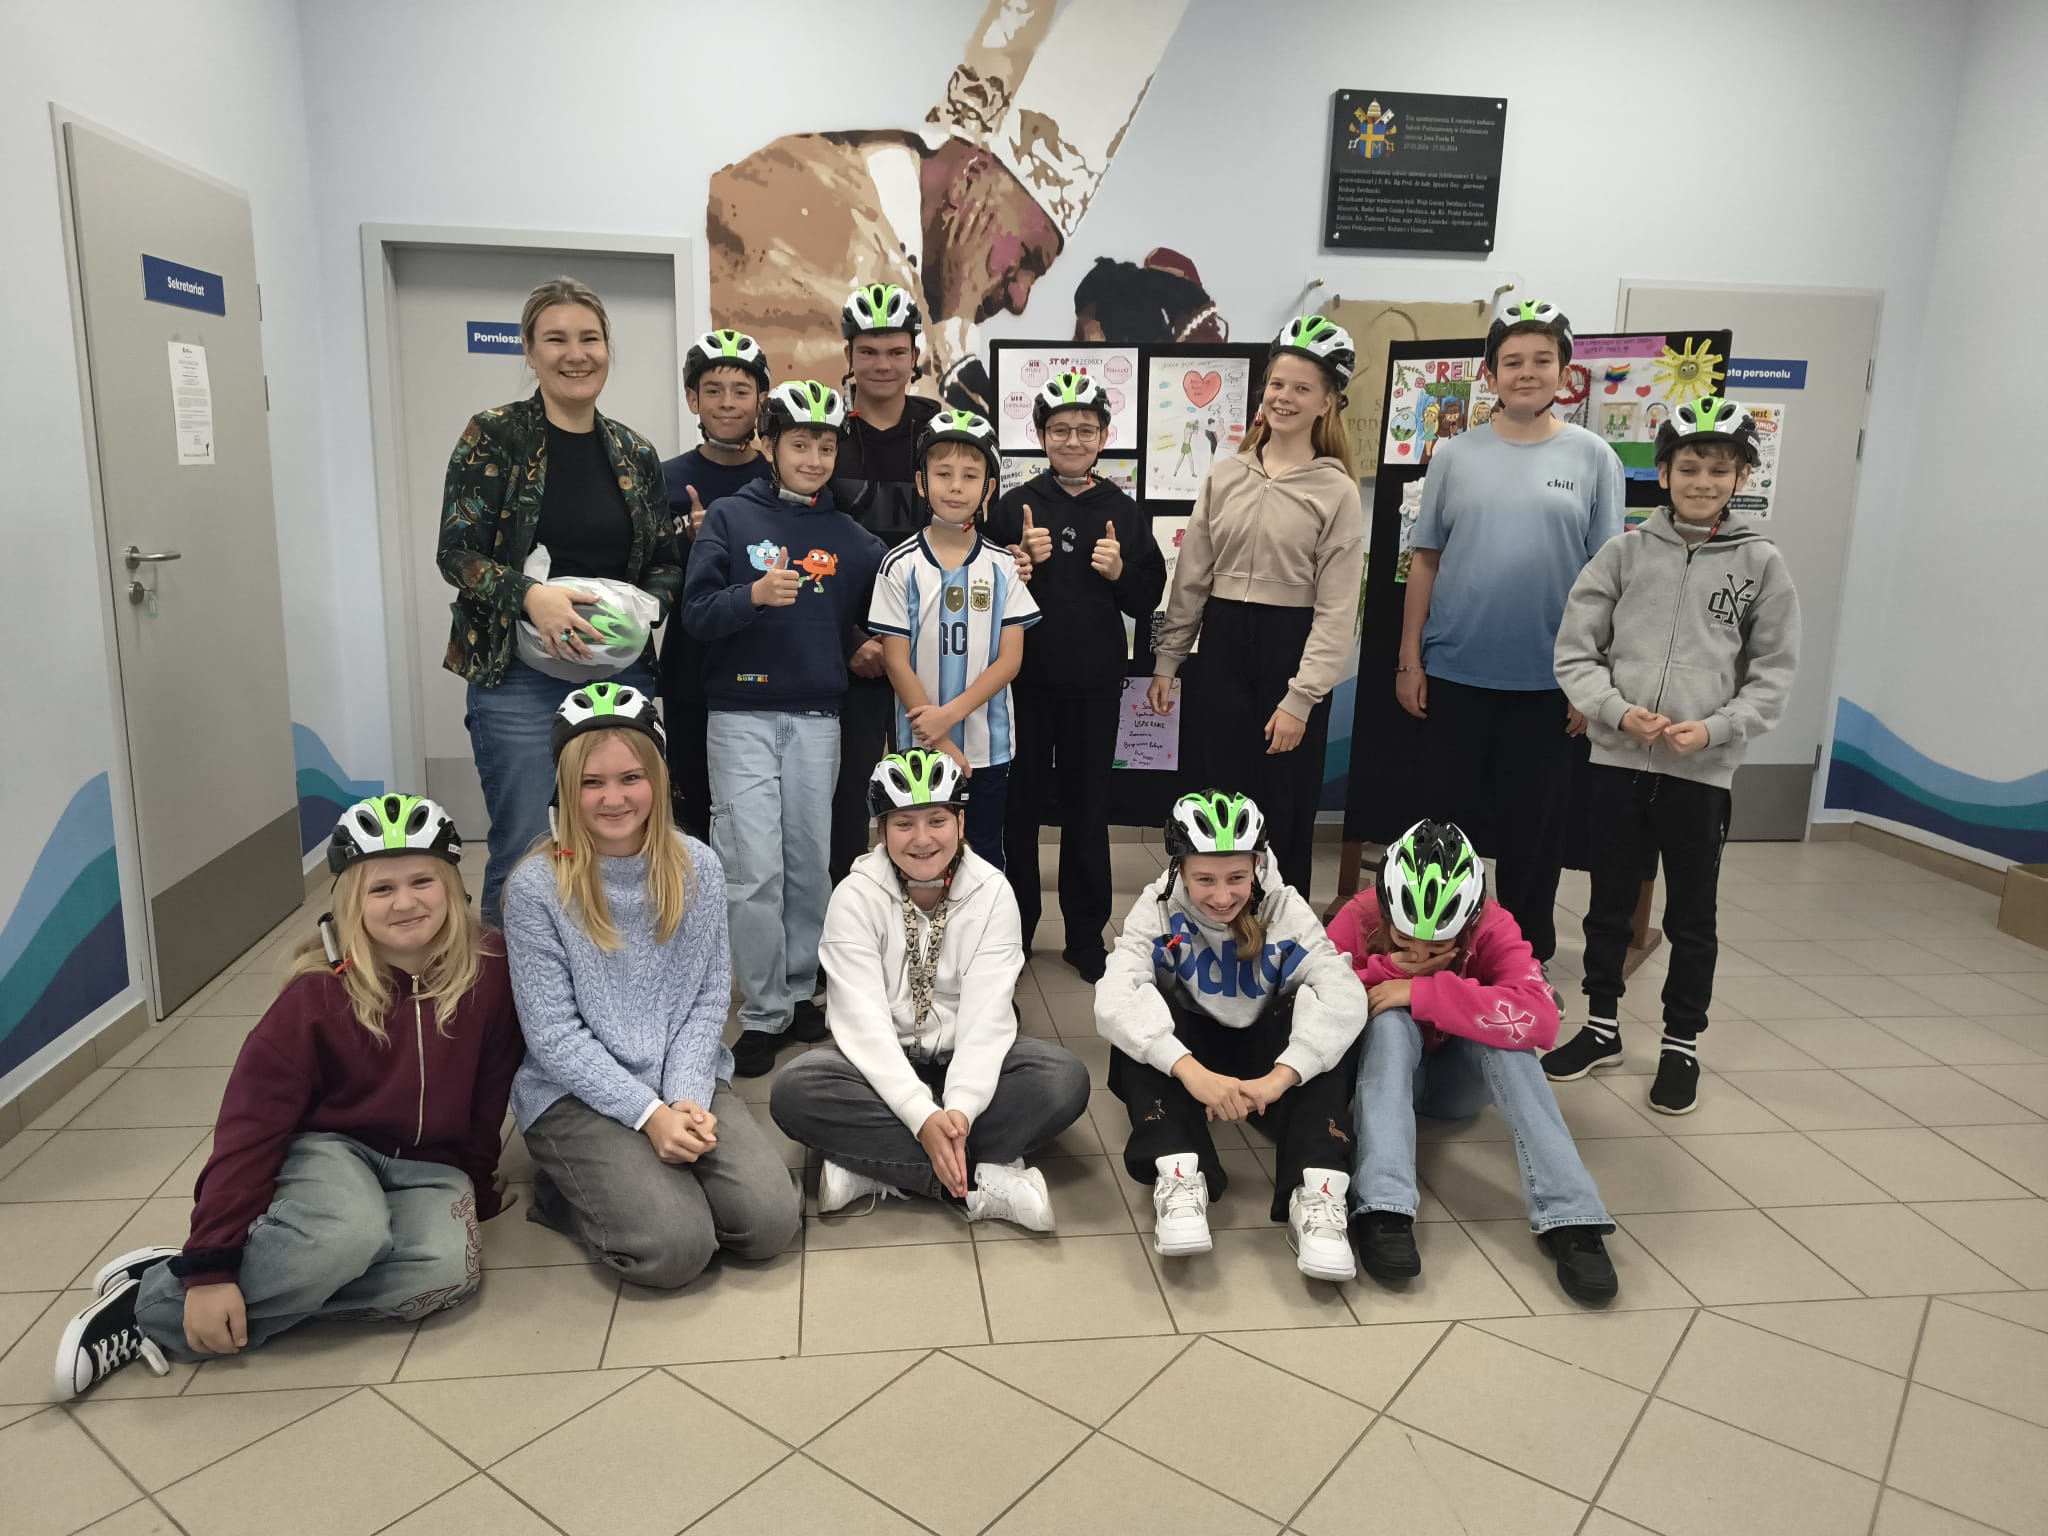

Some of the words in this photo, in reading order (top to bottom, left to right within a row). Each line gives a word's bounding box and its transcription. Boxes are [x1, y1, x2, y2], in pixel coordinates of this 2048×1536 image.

[167, 276, 205, 296] Sekretariat
[1437, 360, 1489, 384] RELA
[1743, 369, 1791, 380] personelu
[1546, 478, 1574, 492] chill
[939, 621, 968, 656] 10
